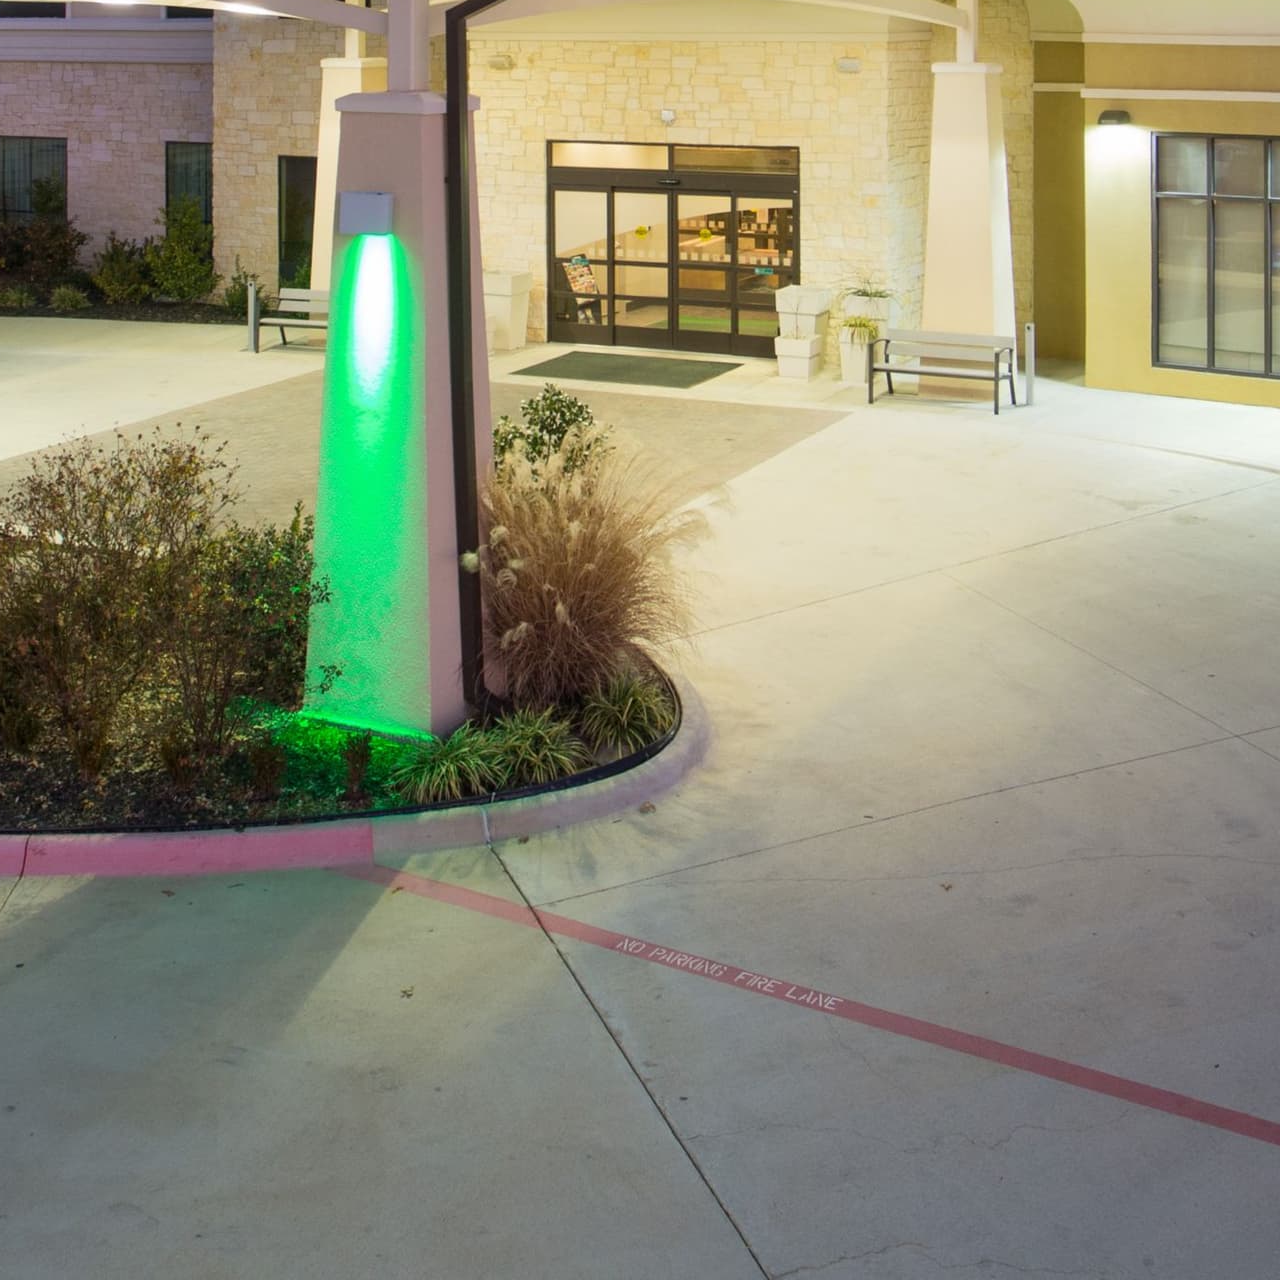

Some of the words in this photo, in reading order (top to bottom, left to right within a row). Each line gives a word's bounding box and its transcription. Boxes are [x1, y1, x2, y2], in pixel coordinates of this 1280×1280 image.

[616, 937, 645, 954] NO
[648, 946, 728, 978] PARKING
[733, 970, 783, 993] FIRE
[785, 985, 845, 1011] LANE
